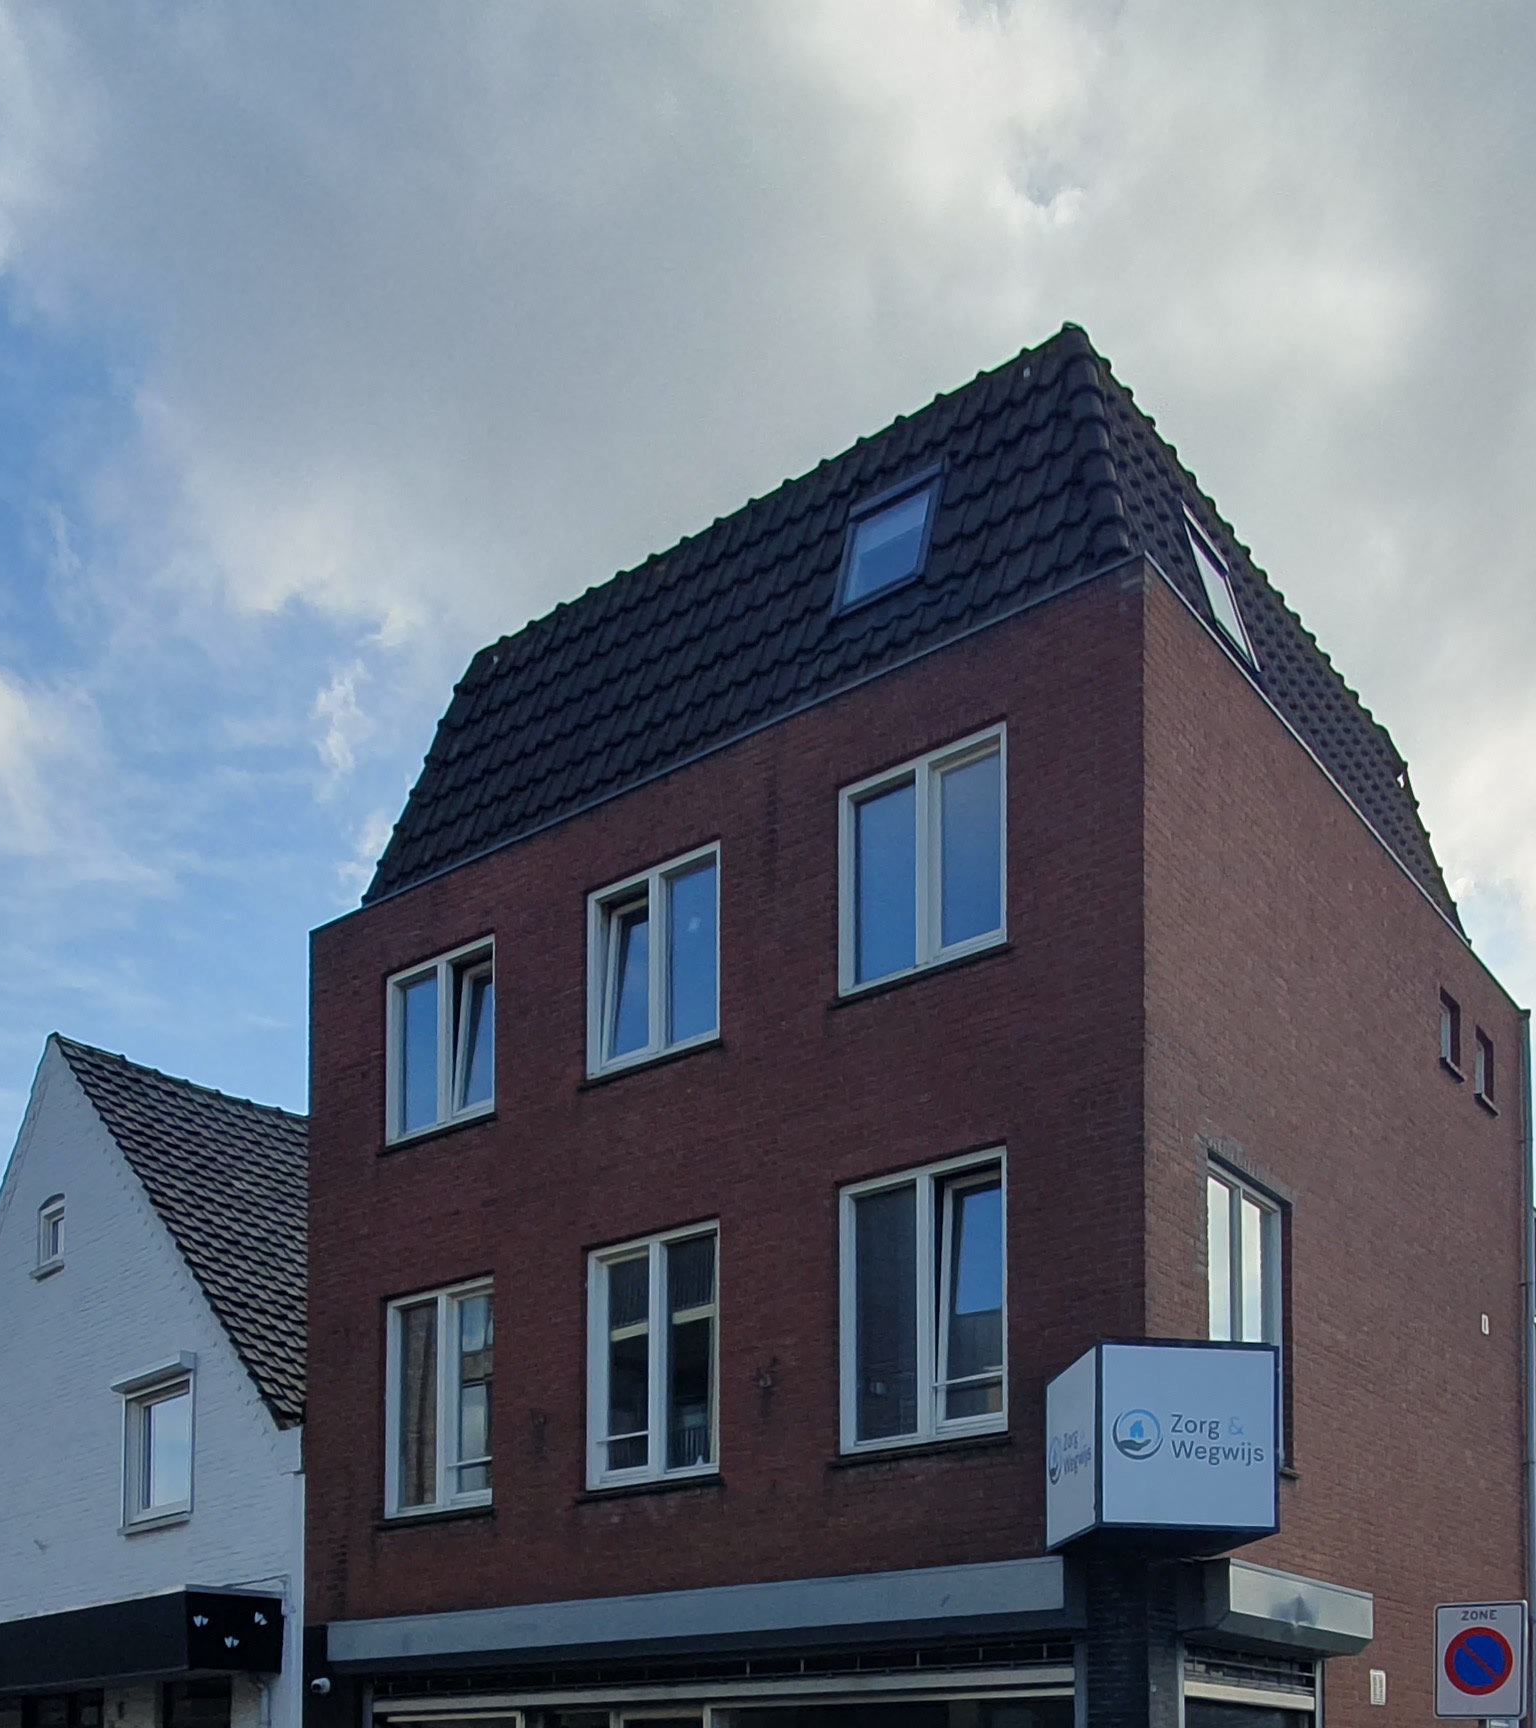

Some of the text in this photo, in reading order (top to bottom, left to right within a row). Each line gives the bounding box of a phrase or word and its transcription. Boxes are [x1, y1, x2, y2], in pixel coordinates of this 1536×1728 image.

[1170, 1413, 1244, 1440] Zorg &
[1171, 1440, 1264, 1467] Wegwijs
[1461, 1609, 1498, 1621] ZONE
